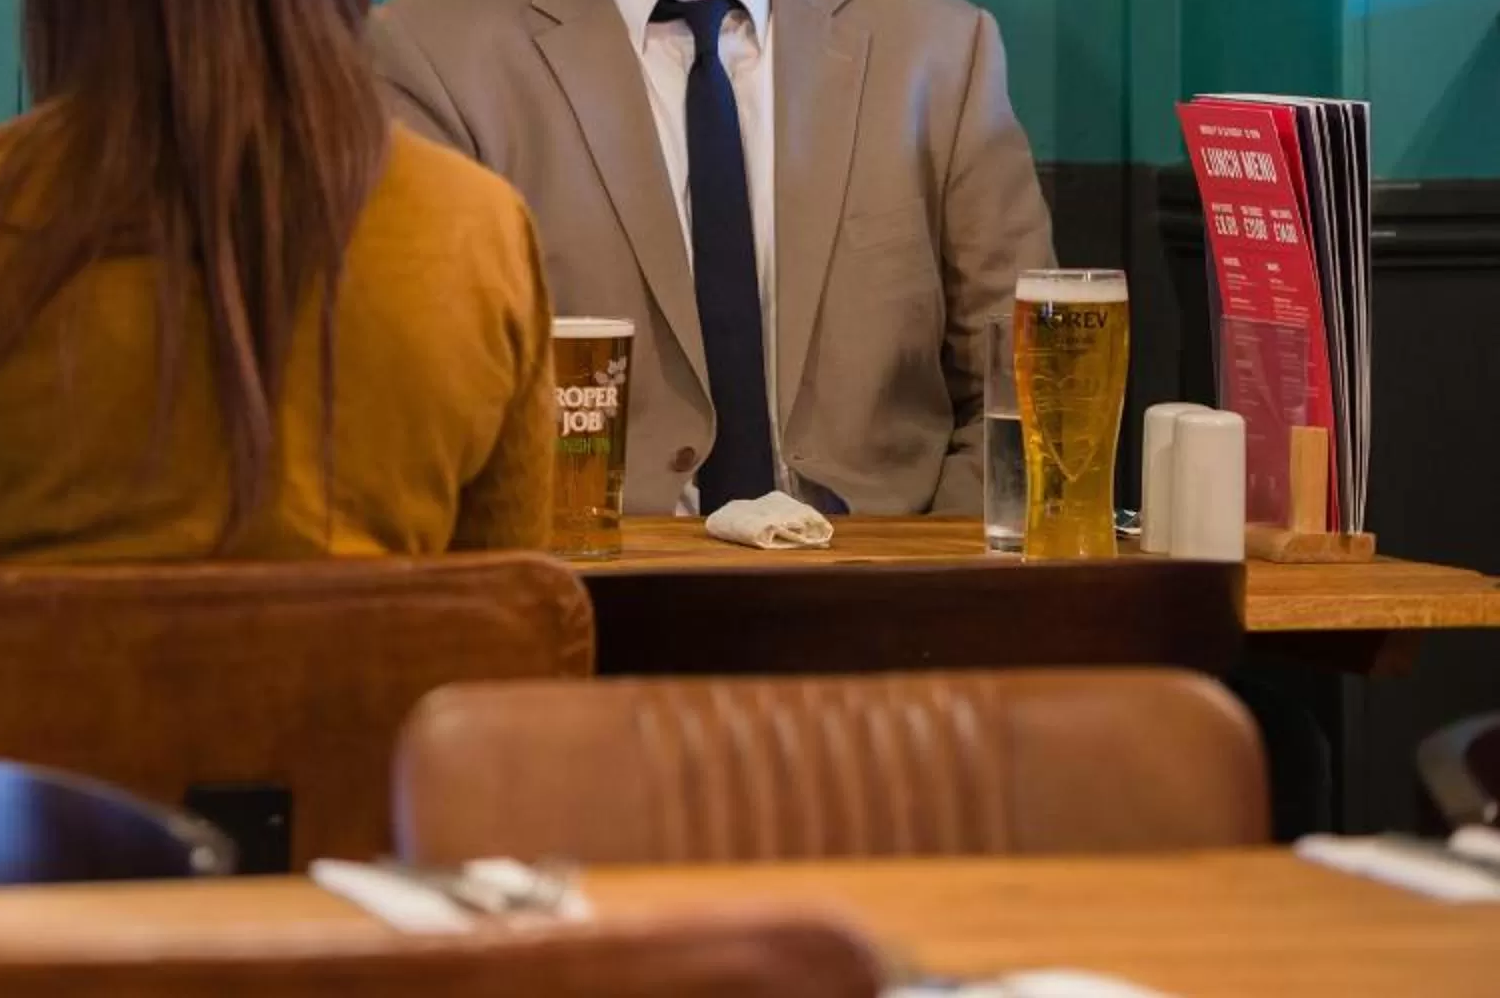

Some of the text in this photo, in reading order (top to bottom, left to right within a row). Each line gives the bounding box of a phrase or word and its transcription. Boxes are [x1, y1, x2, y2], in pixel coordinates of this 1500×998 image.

[1200, 146, 1277, 184] LUNCH MENU
[555, 387, 618, 408] ROPER
[562, 411, 604, 436] JOB
